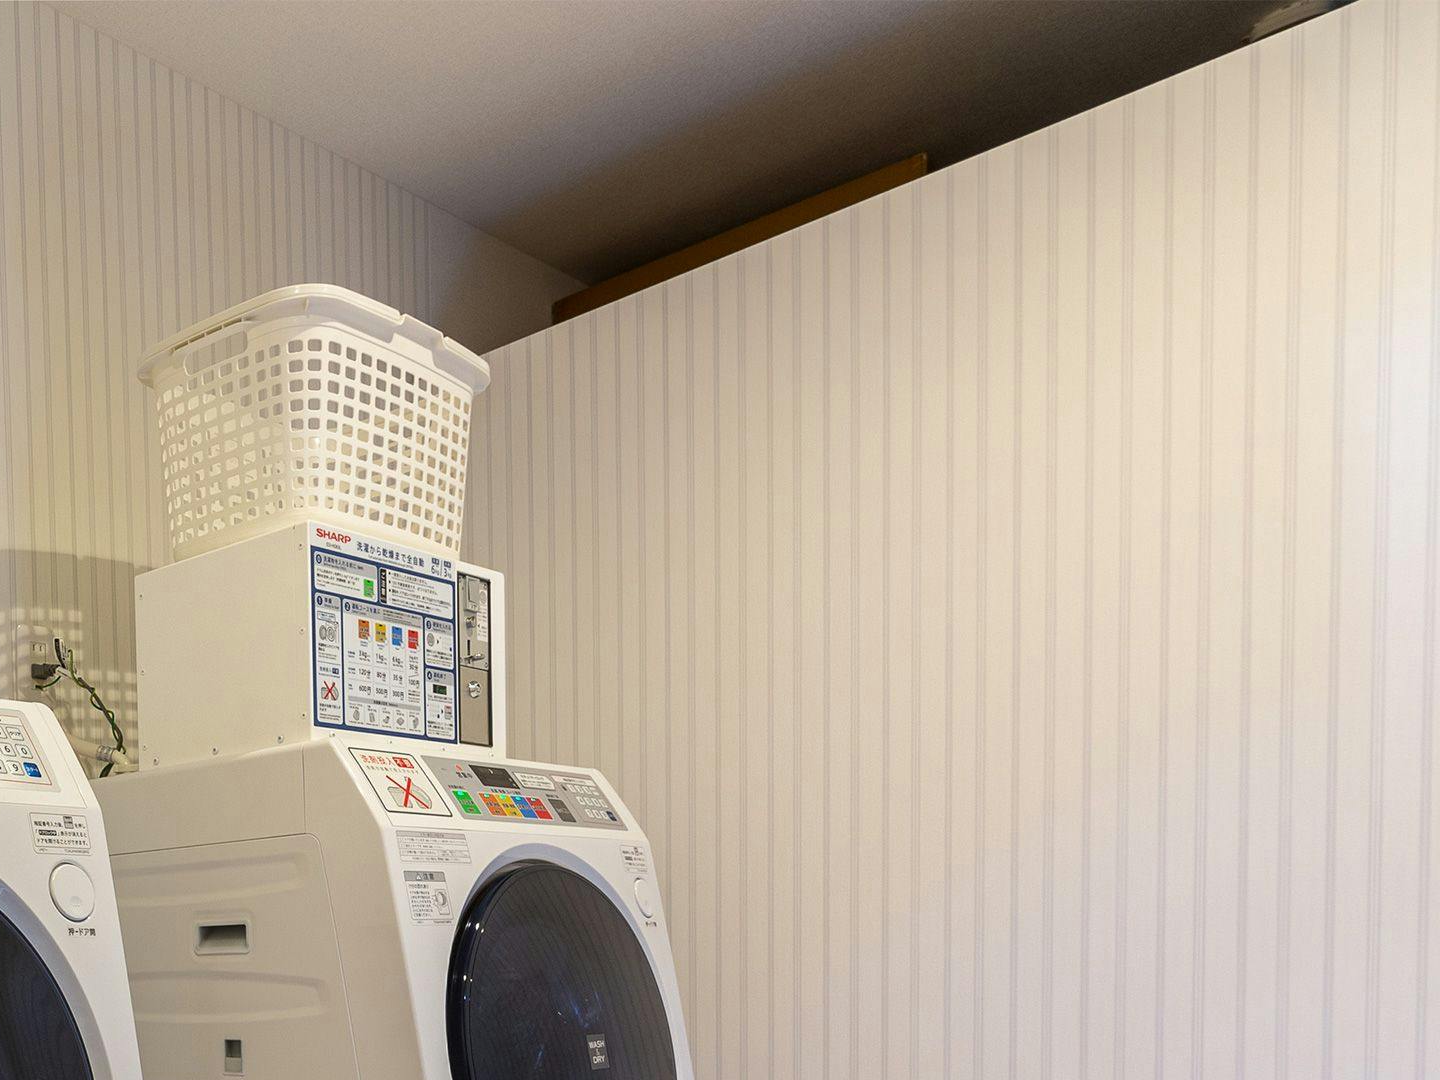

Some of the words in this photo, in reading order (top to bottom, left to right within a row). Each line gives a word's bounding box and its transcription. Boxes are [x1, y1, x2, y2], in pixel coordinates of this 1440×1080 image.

[316, 528, 352, 544] SHARP
[588, 1040, 605, 1049] WASH
[592, 1055, 605, 1064] DRY
